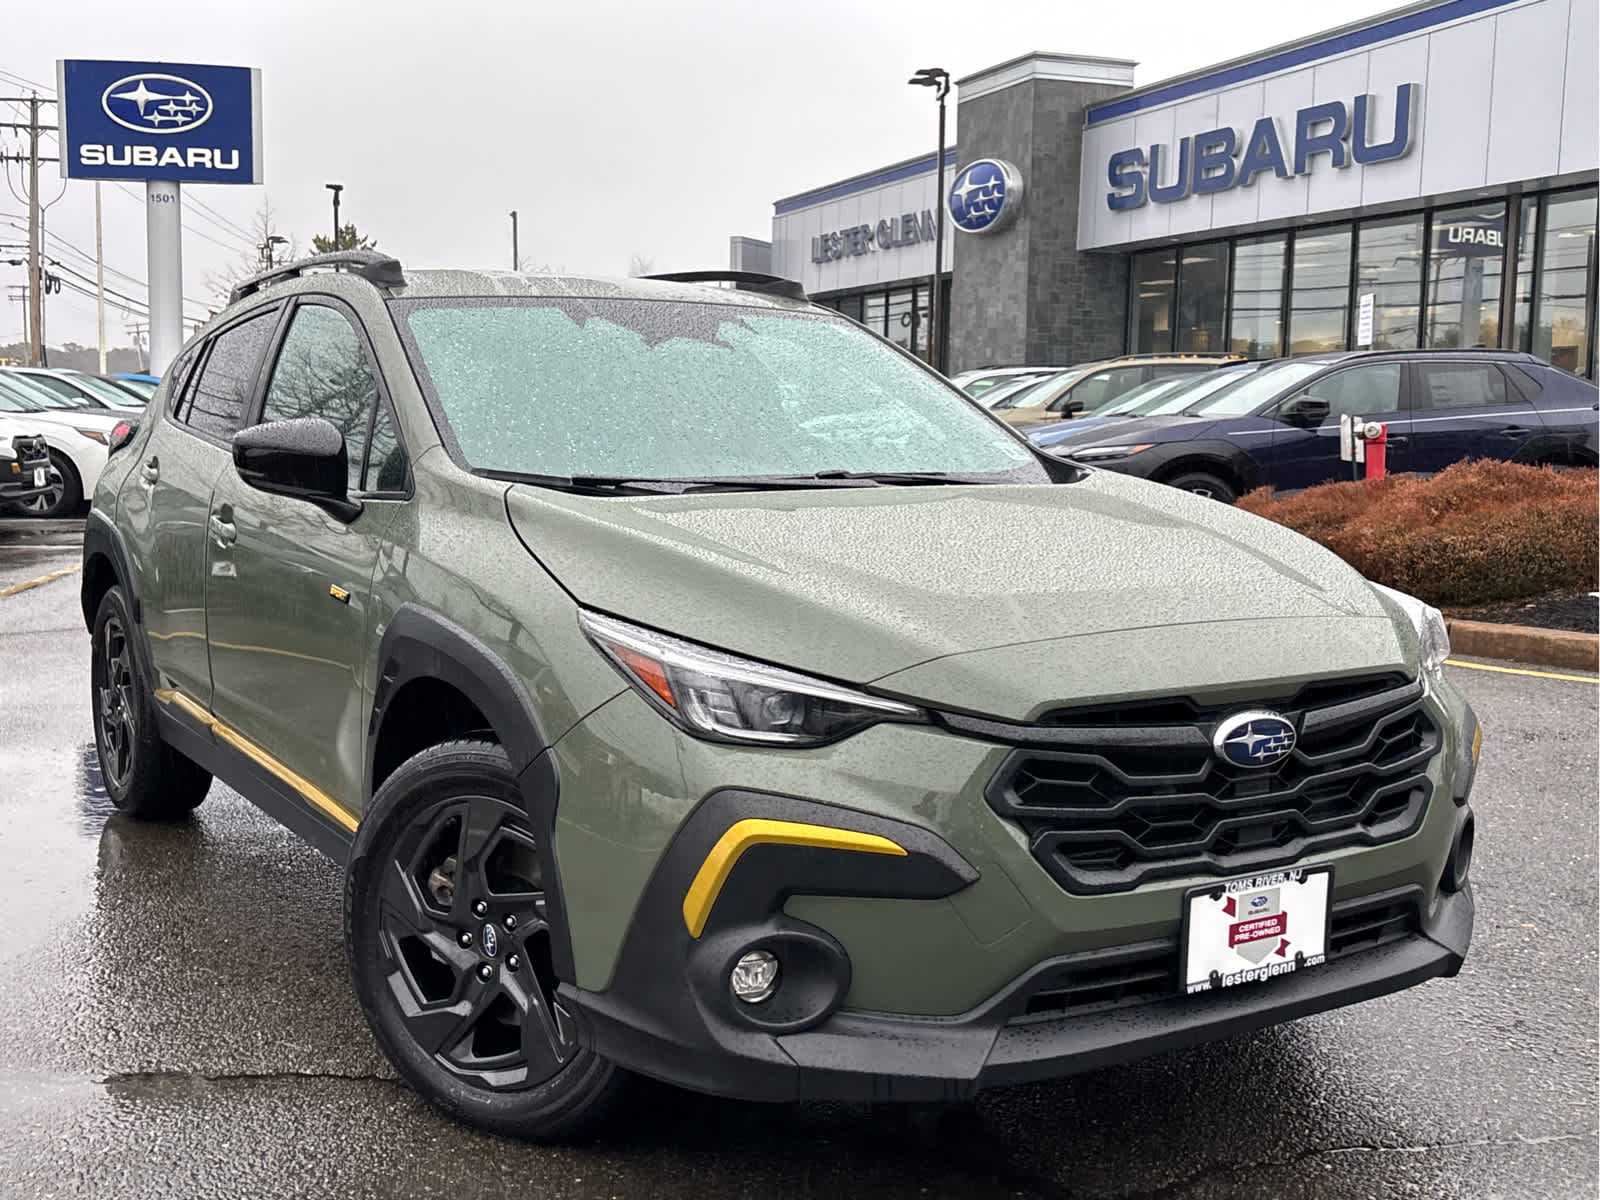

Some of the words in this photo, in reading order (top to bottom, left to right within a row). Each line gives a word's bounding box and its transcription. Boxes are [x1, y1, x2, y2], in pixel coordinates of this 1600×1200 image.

[79, 144, 240, 170] SUBARU
[1106, 83, 1415, 211] SUBARU
[150, 193, 176, 204] 1501
[811, 223, 875, 264] LESTER
[1224, 879, 1253, 893] TOMS
[1289, 868, 1303, 881] NJ
[1234, 925, 1281, 942] PRE-OWNED
[1238, 918, 1278, 933] CERTIFIED
